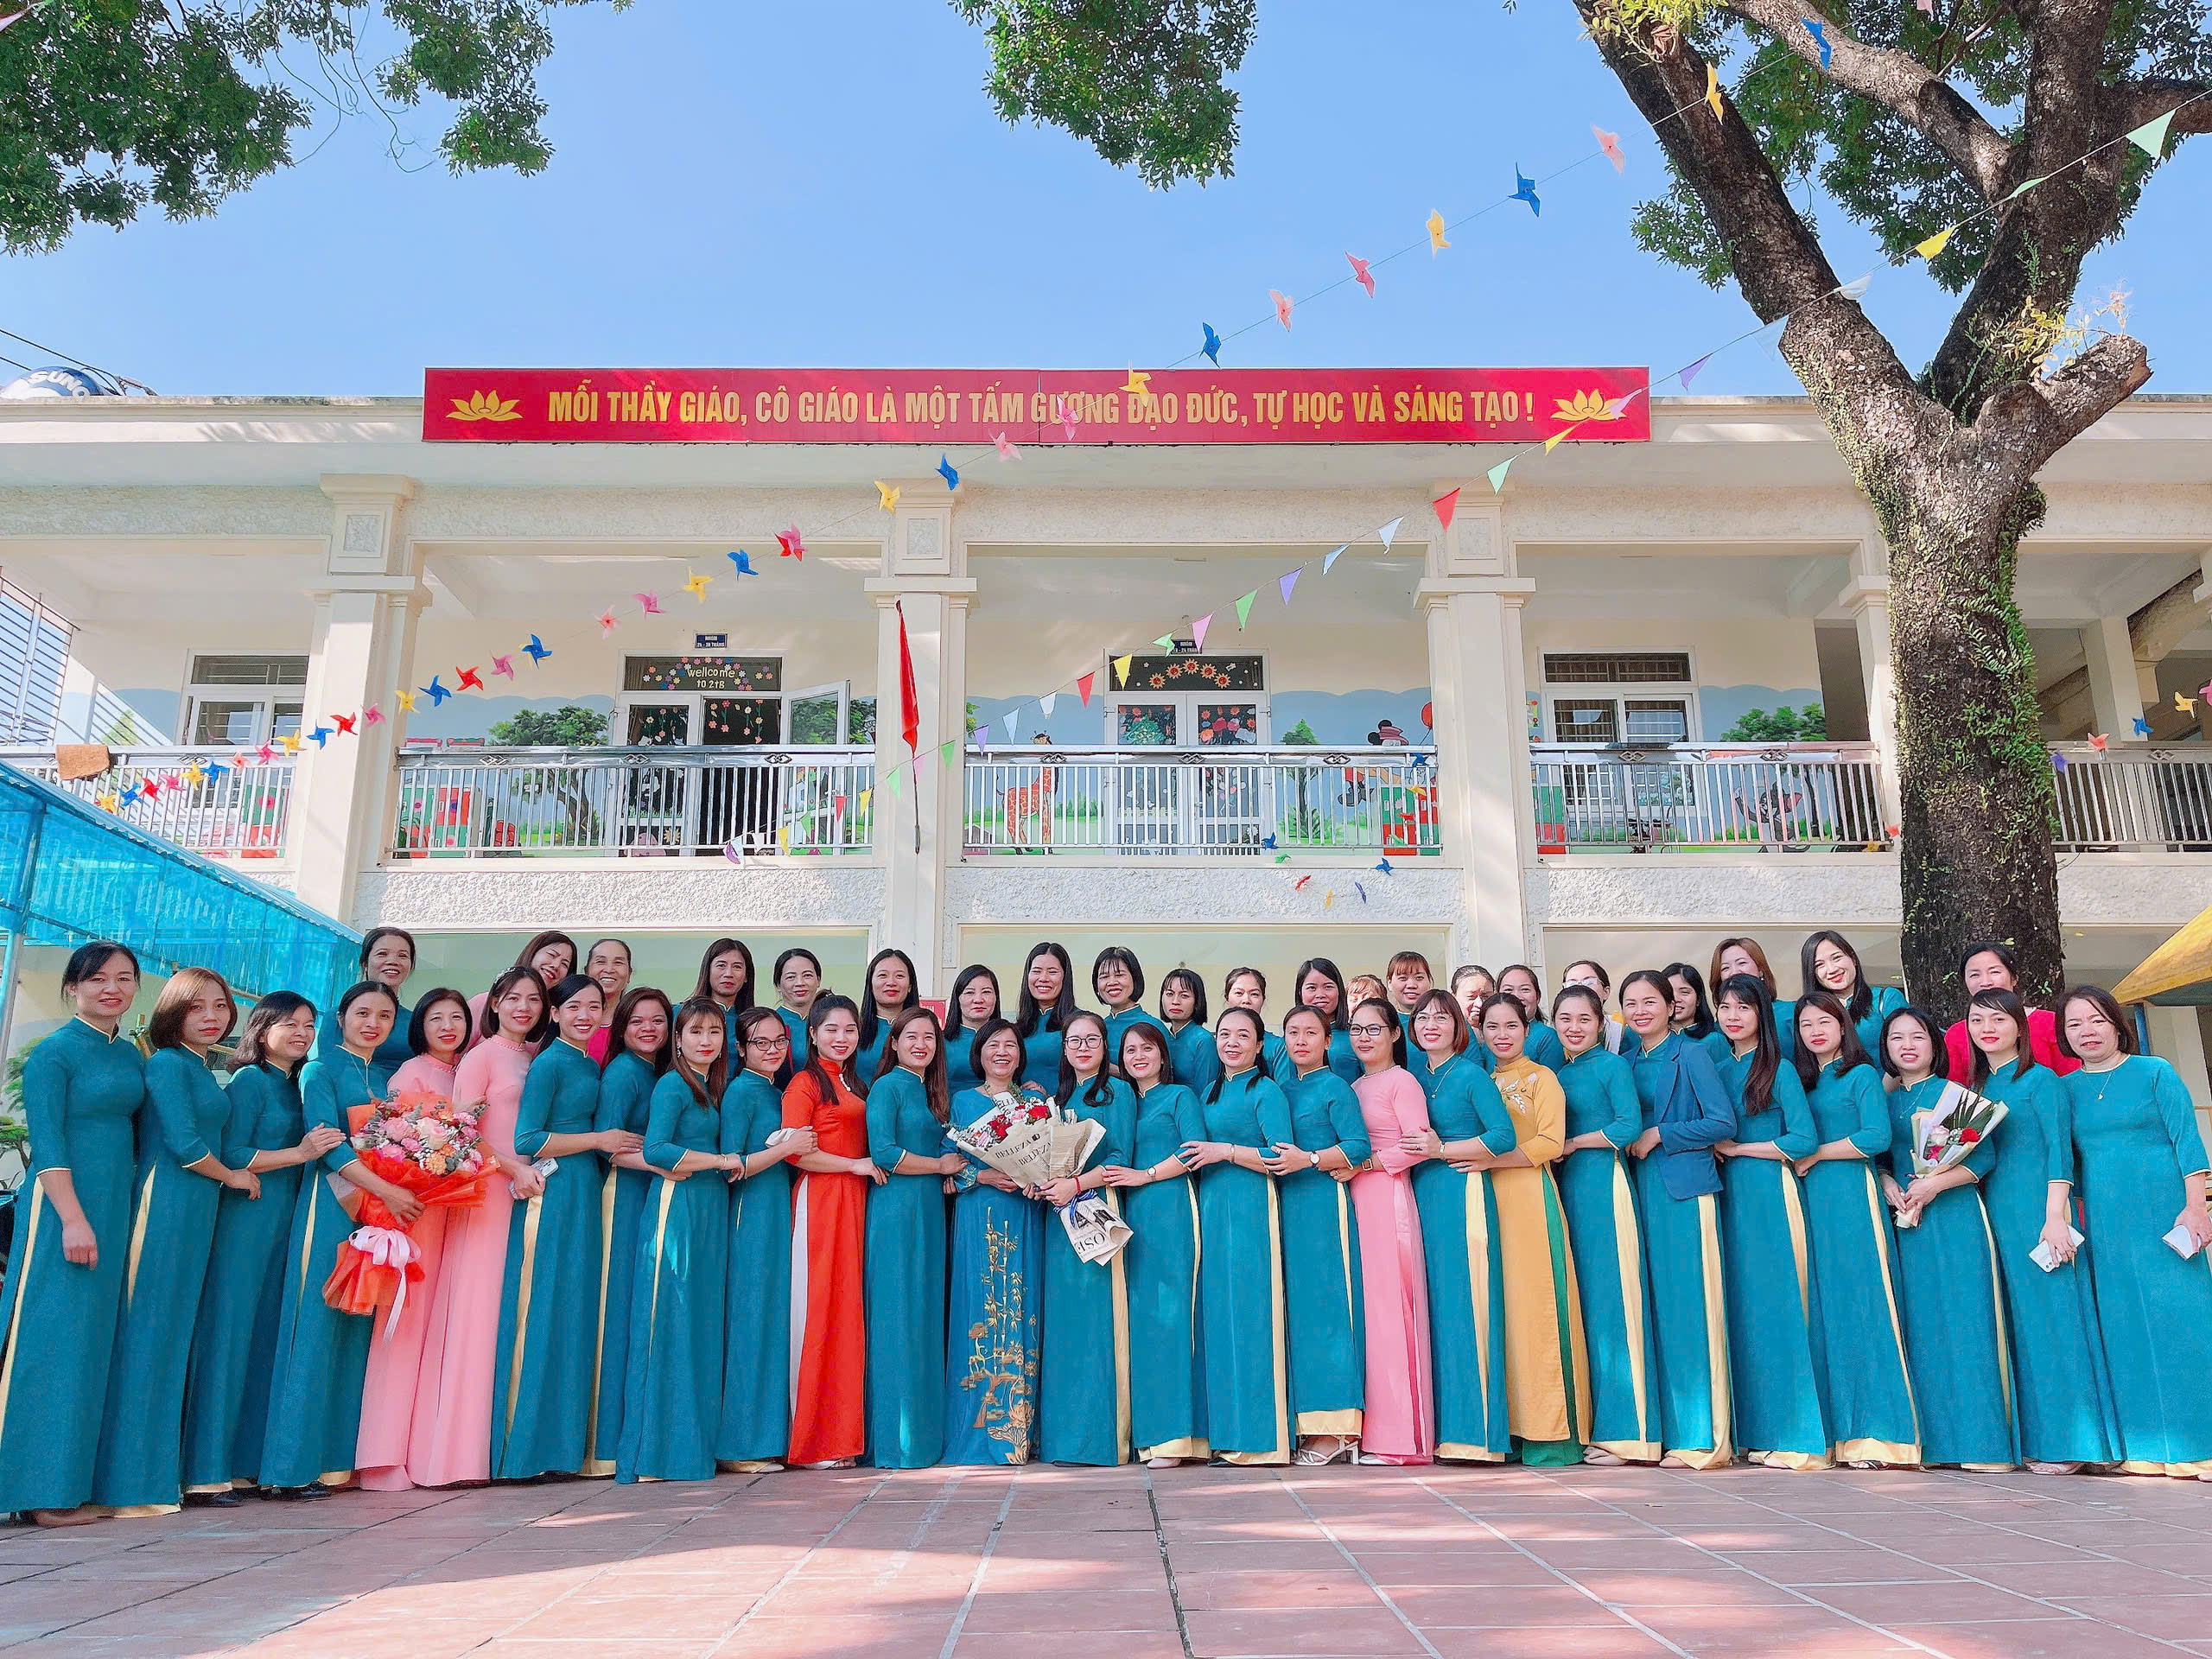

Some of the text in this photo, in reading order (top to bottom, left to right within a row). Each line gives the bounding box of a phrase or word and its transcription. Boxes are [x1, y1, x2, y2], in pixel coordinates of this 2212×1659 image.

[548, 379, 598, 422] MỖI
[607, 380, 671, 422] THẦY
[680, 385, 747, 426] GIÁO,
[755, 385, 790, 423] CÔ
[798, 386, 859, 423] GIÁO
[866, 386, 898, 423] LÀ
[905, 385, 961, 429] MỘT
[969, 381, 1024, 423] TẤM
[1128, 392, 1178, 430] ĐẠO
[1186, 385, 1248, 427] ĐỨC,
[1253, 390, 1287, 429] TỰ
[1294, 392, 1344, 429] HỌC
[1352, 385, 1386, 423] VÀ
[1394, 385, 1463, 423] SÁNG
[1471, 391, 1519, 429] TẠO
